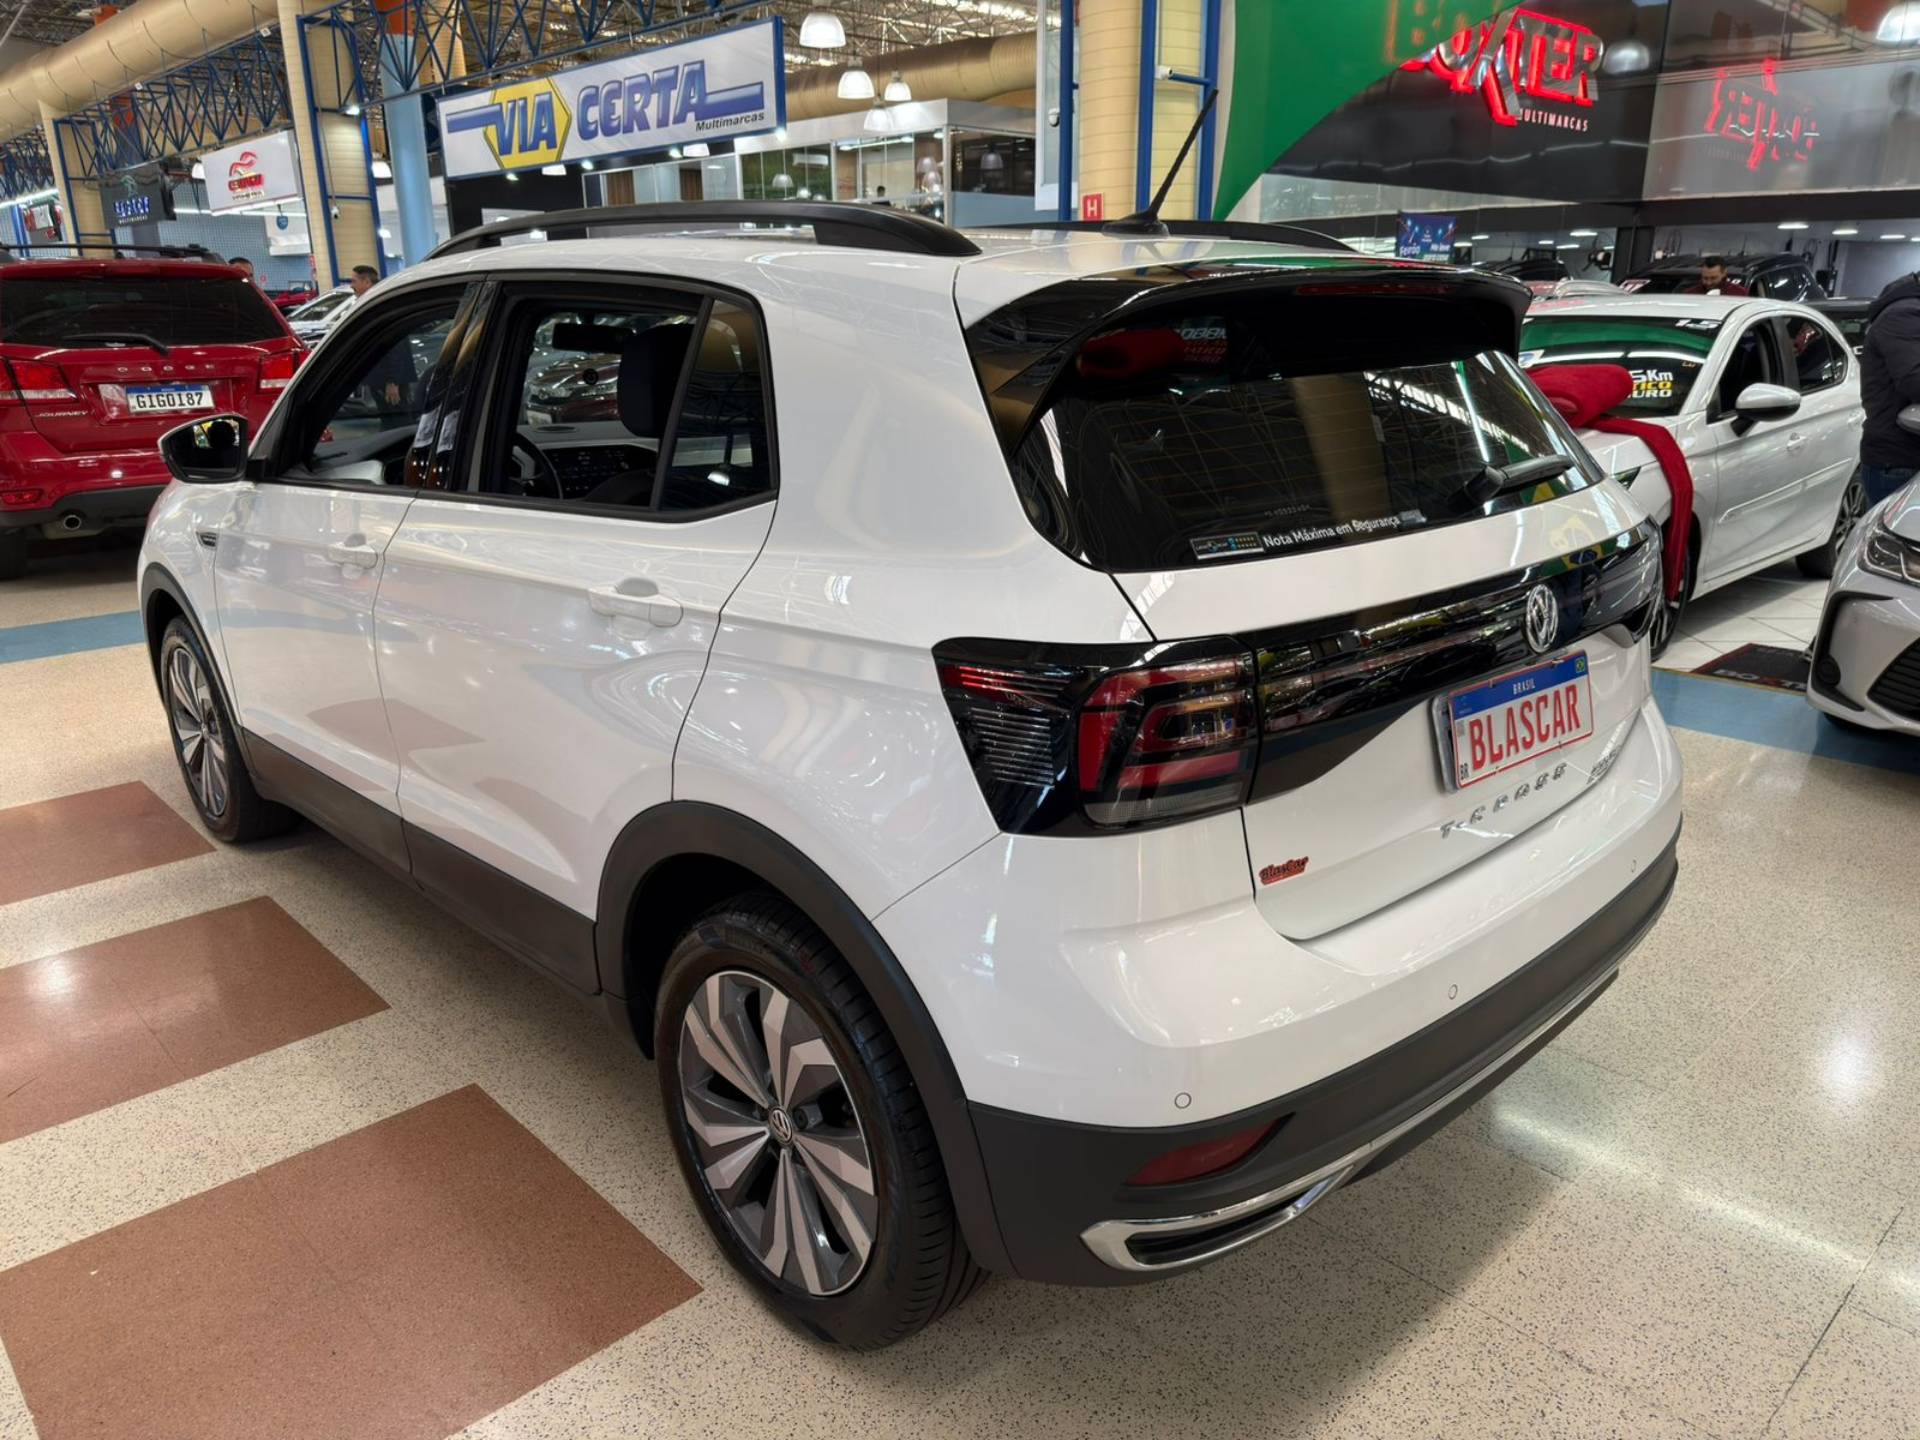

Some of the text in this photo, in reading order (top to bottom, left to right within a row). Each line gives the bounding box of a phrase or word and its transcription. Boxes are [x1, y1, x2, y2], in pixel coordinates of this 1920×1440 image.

[490, 60, 706, 155] VIA CERTA
[695, 111, 765, 133] Multimarcas
[1085, 198, 1098, 218] H
[1627, 389, 1673, 399] URO
[1263, 534, 1293, 548] Nota
[1293, 526, 1335, 543] Máxima
[1335, 523, 1354, 535] em
[1352, 515, 1400, 533] Segurança
[1513, 678, 1536, 695] BRASIL
[1469, 684, 1581, 771] BLASCAR
